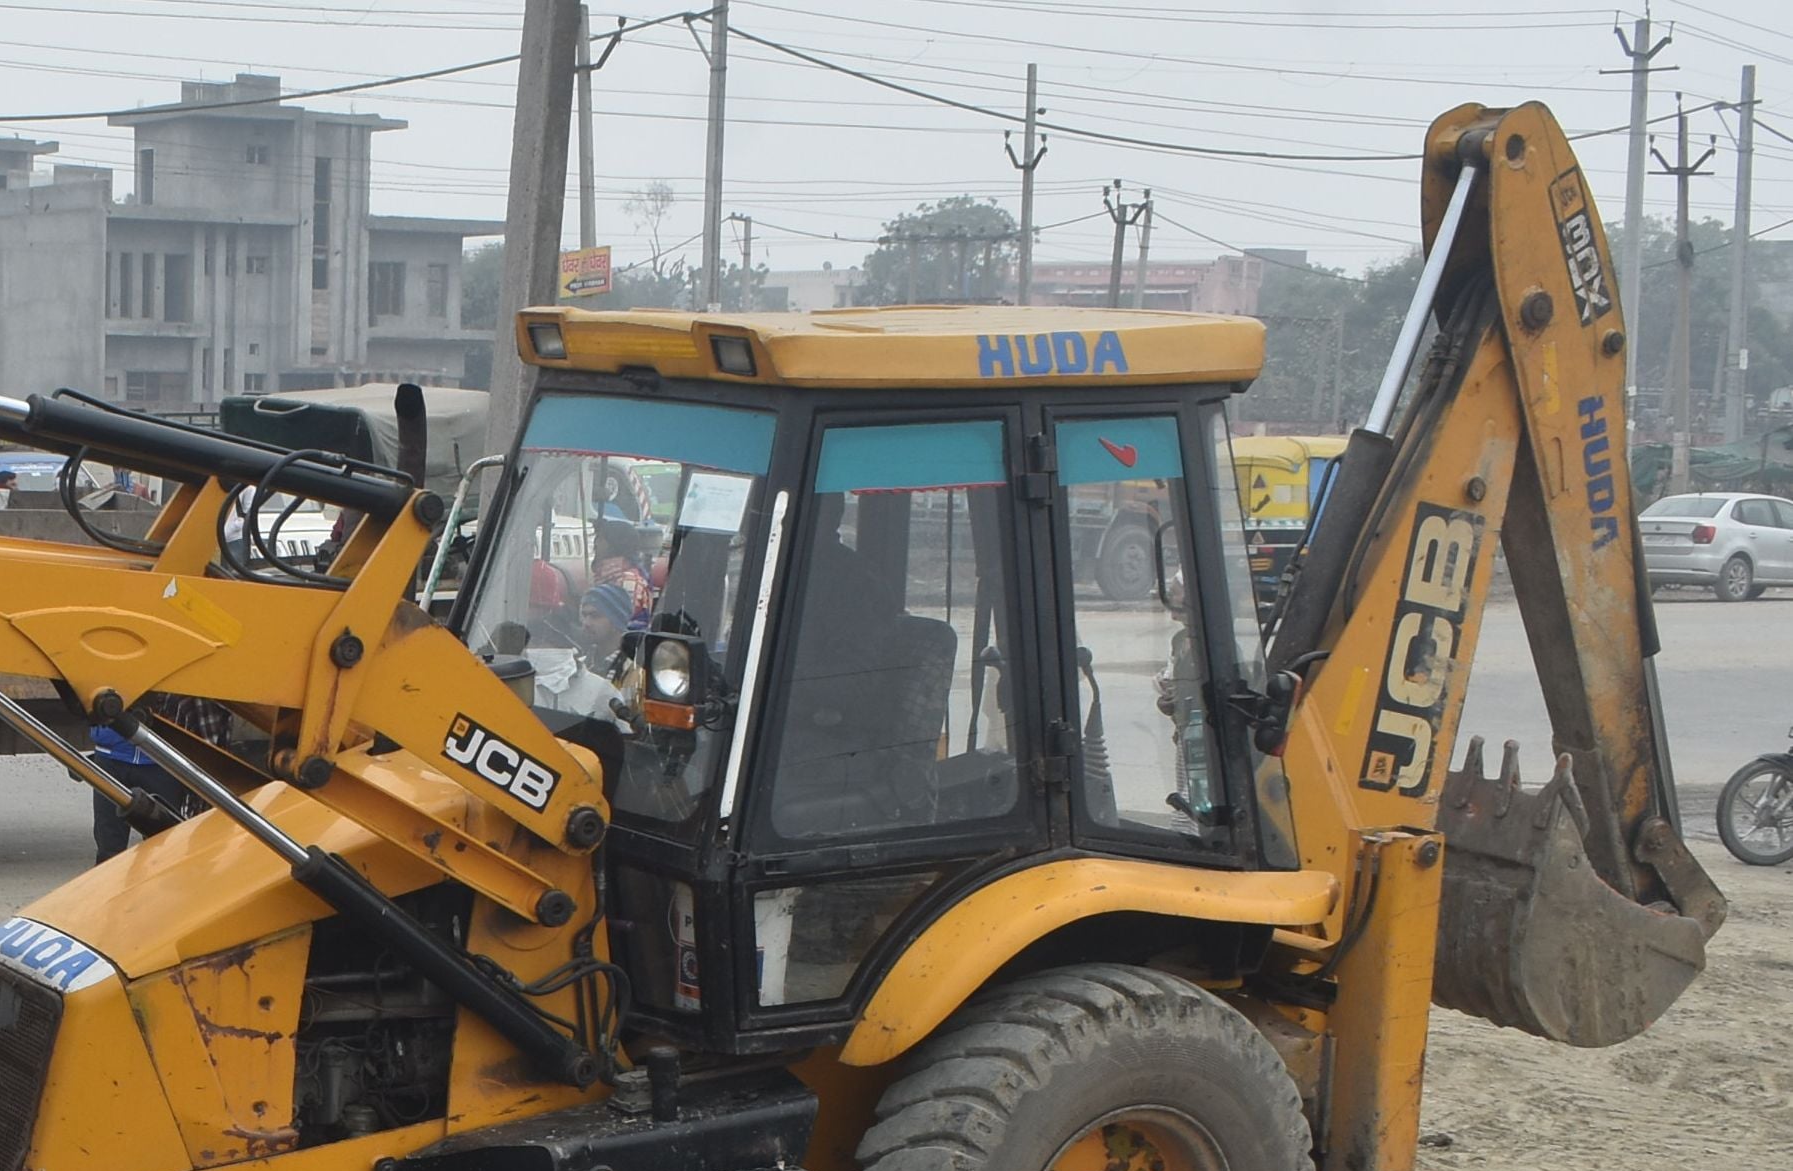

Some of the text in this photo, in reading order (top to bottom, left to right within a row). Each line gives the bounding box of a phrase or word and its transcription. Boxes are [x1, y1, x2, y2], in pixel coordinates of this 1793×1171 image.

[977, 331, 1129, 377] HUDA
[1376, 514, 1474, 789] JCB
[445, 728, 554, 808] JCB
